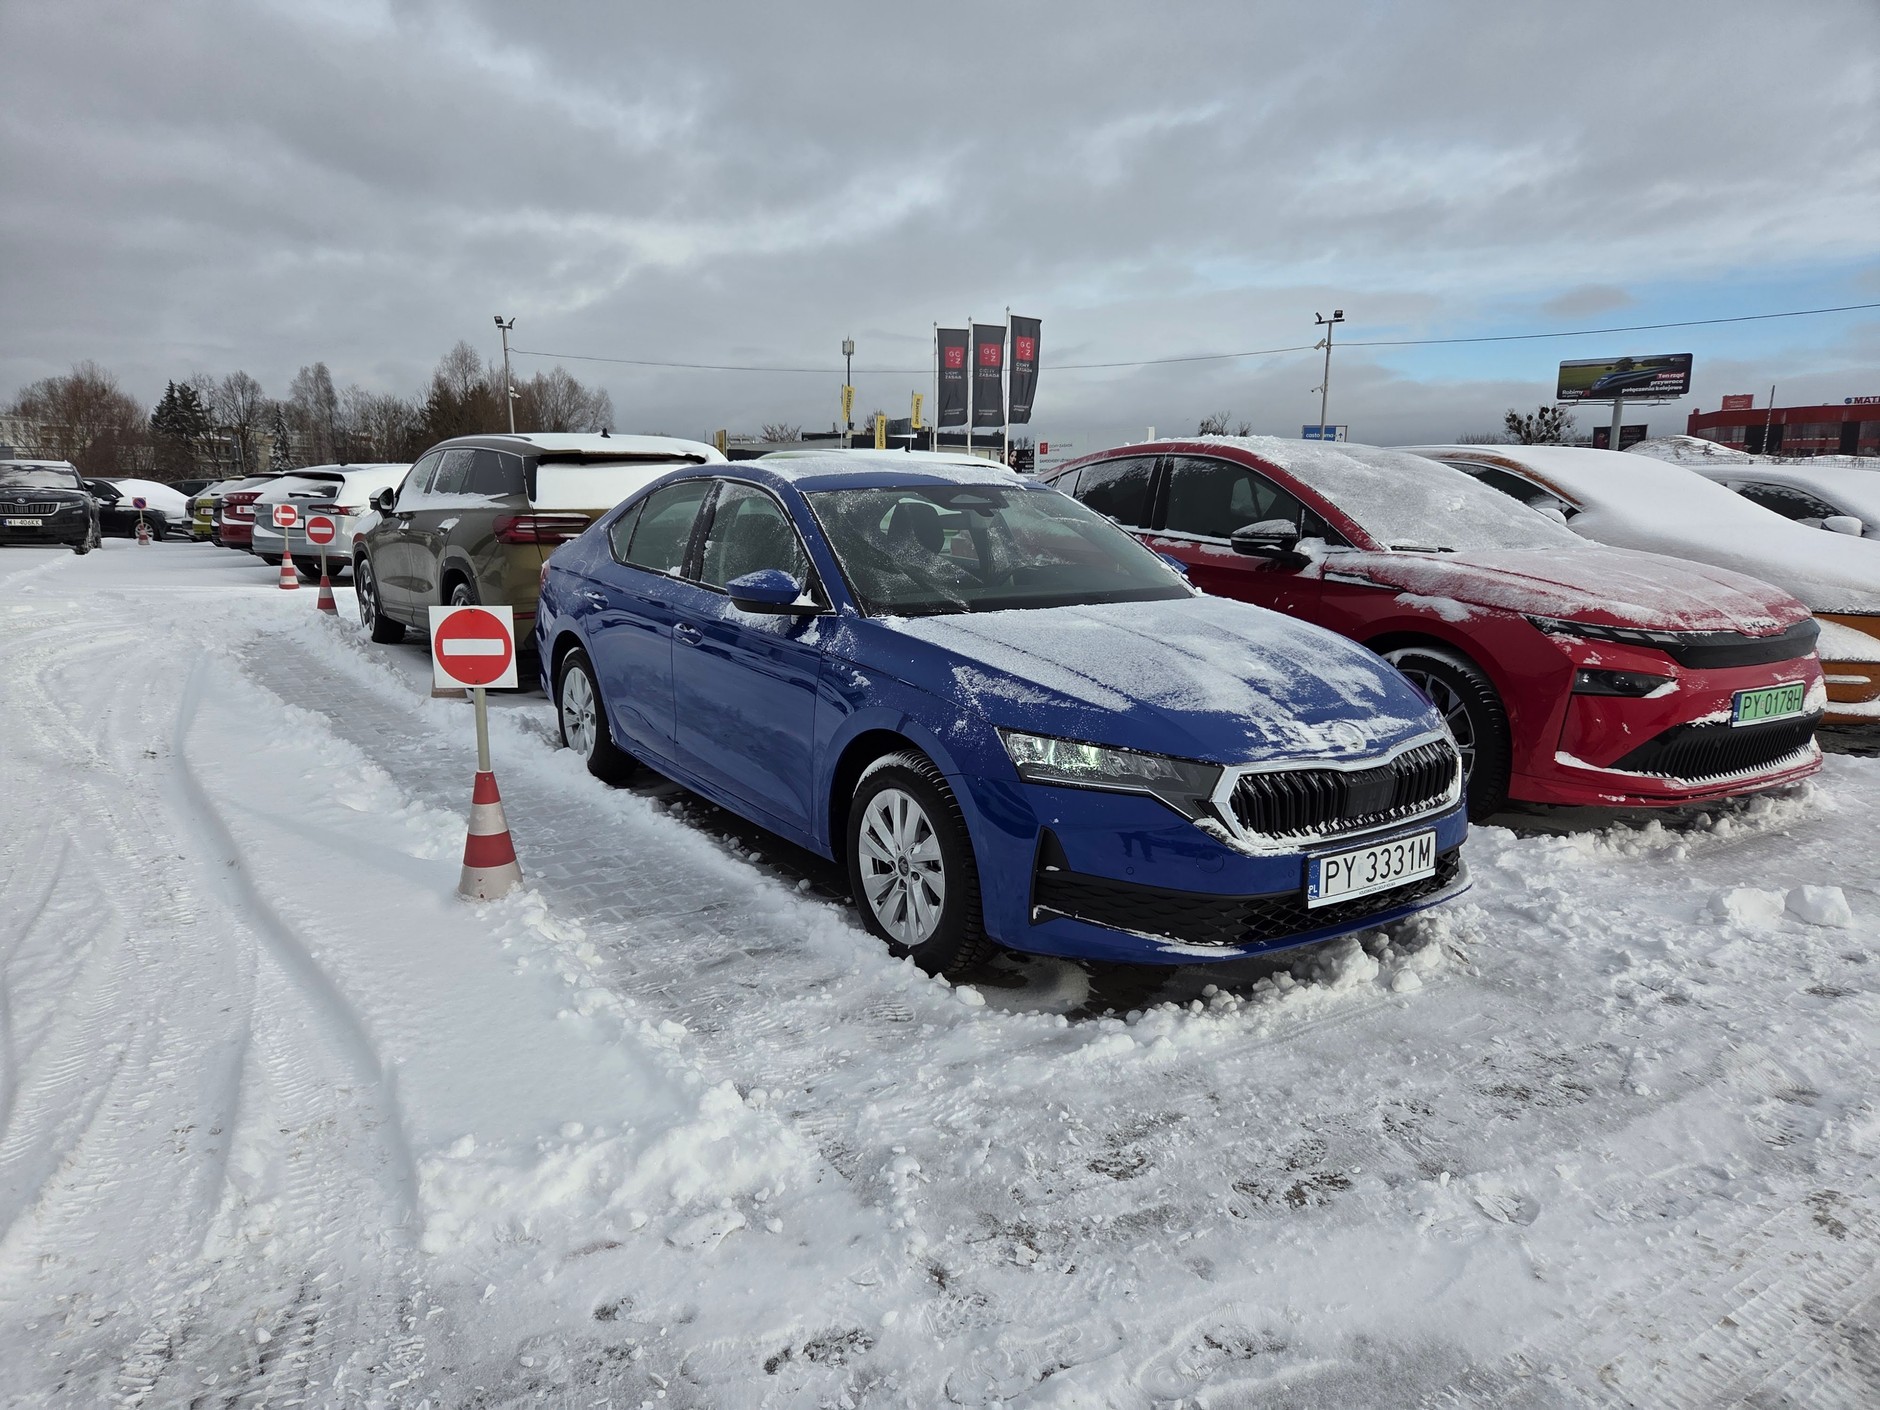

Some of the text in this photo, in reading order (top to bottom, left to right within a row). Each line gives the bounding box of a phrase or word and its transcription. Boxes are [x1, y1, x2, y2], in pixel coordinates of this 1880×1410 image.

[1742, 688, 1802, 719] PY 0178H
[1324, 836, 1431, 894] PY 3331M
[1308, 885, 1318, 895] PL
